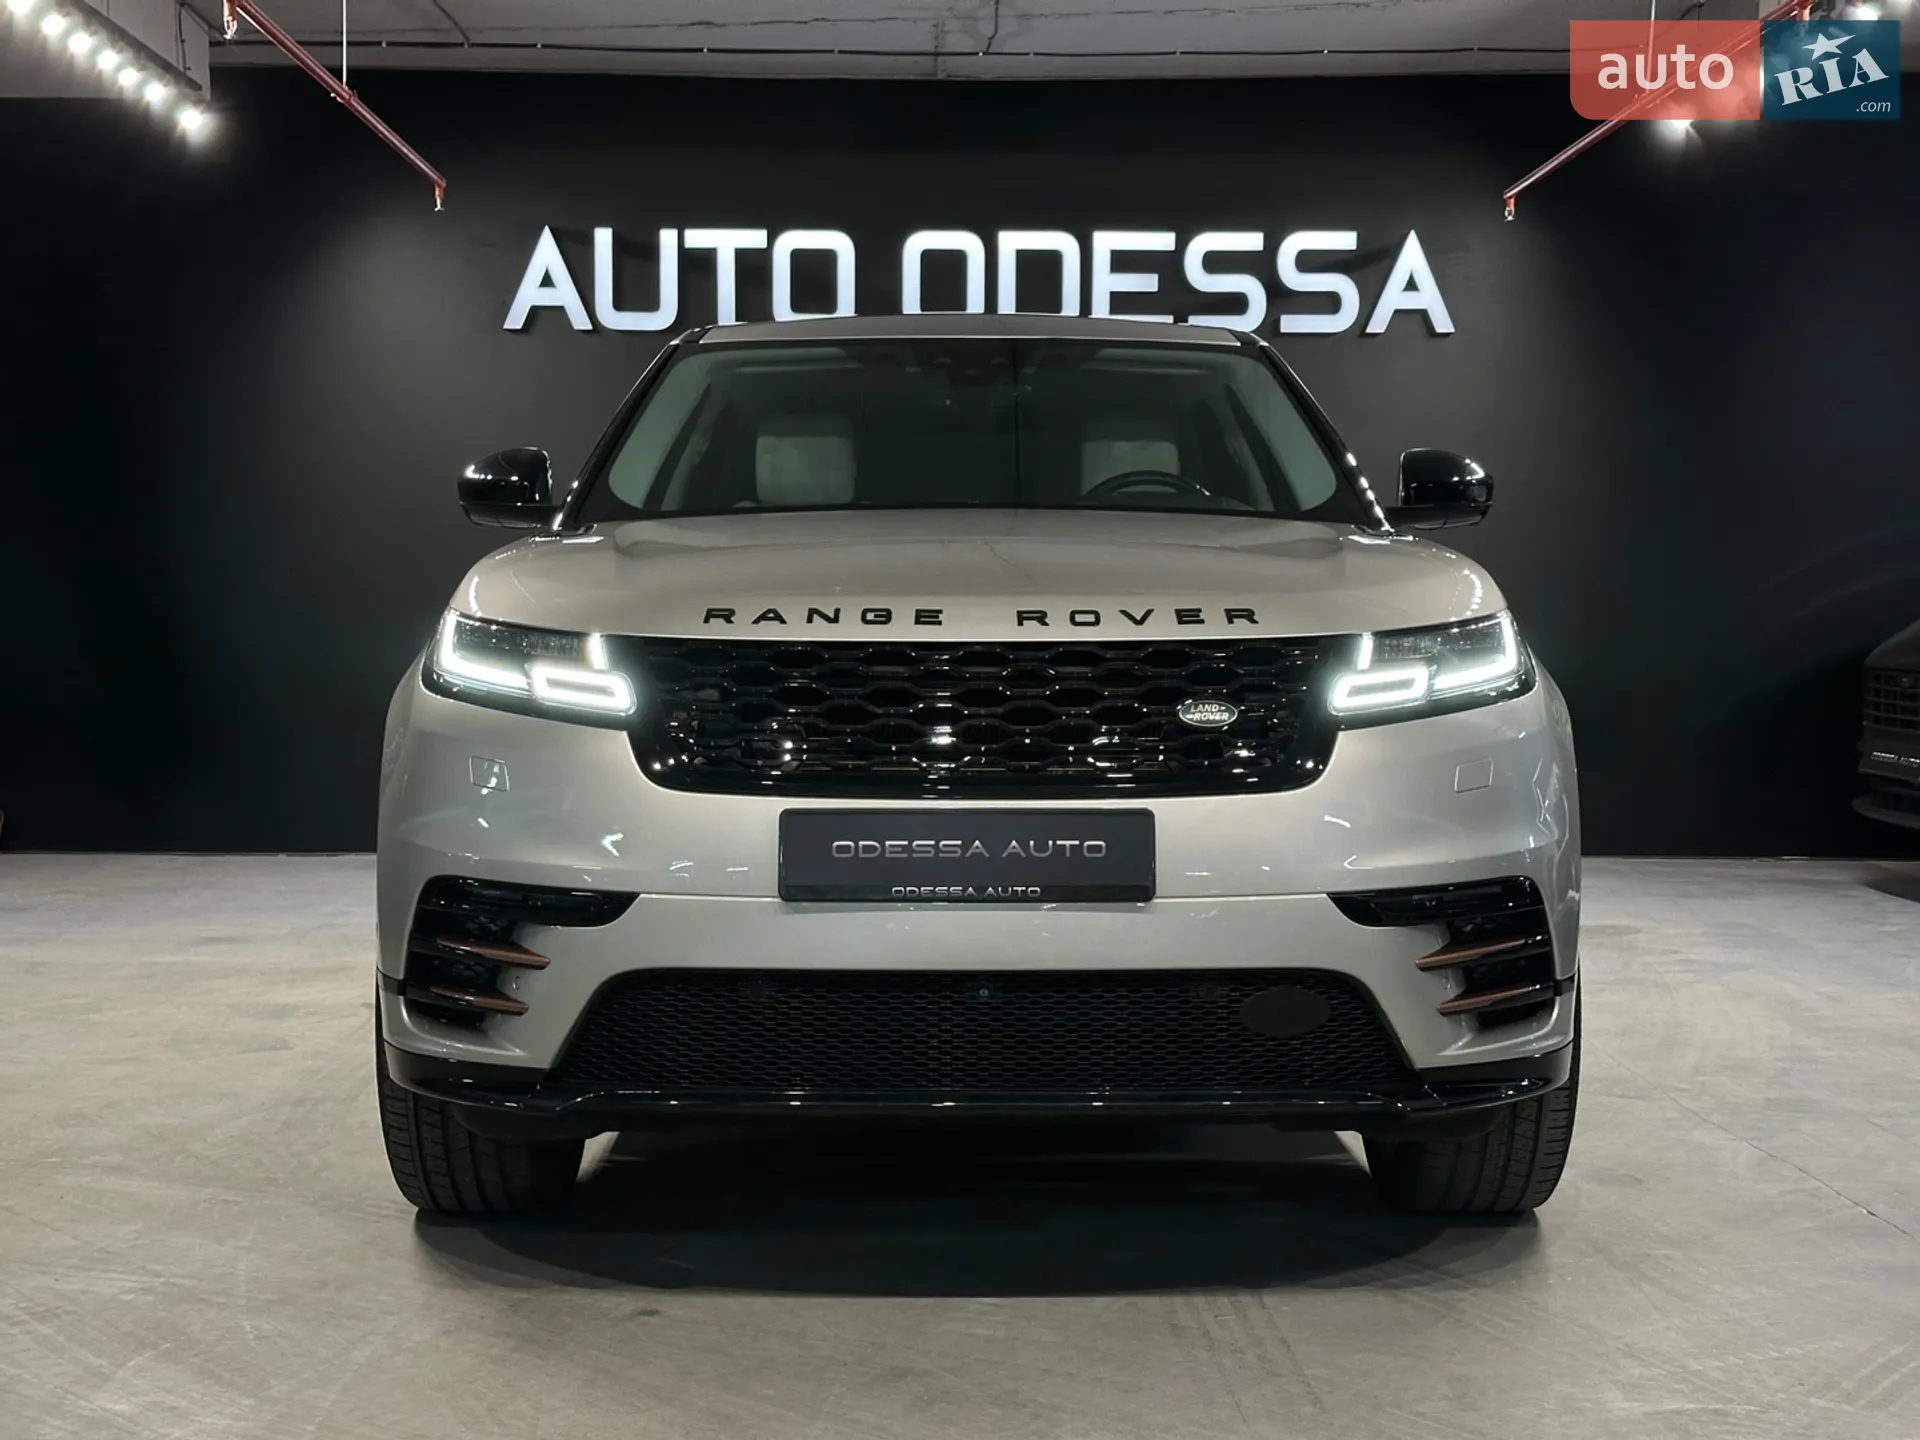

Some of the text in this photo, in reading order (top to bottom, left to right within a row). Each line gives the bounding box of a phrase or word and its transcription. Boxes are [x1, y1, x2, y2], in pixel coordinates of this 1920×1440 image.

[503, 225, 1454, 334] AUTO ODESSA
[703, 608, 1260, 626] RANGE ROVER
[832, 840, 1107, 858] ODESSA AUTO
[891, 887, 1041, 897] ODESSA AUTO
